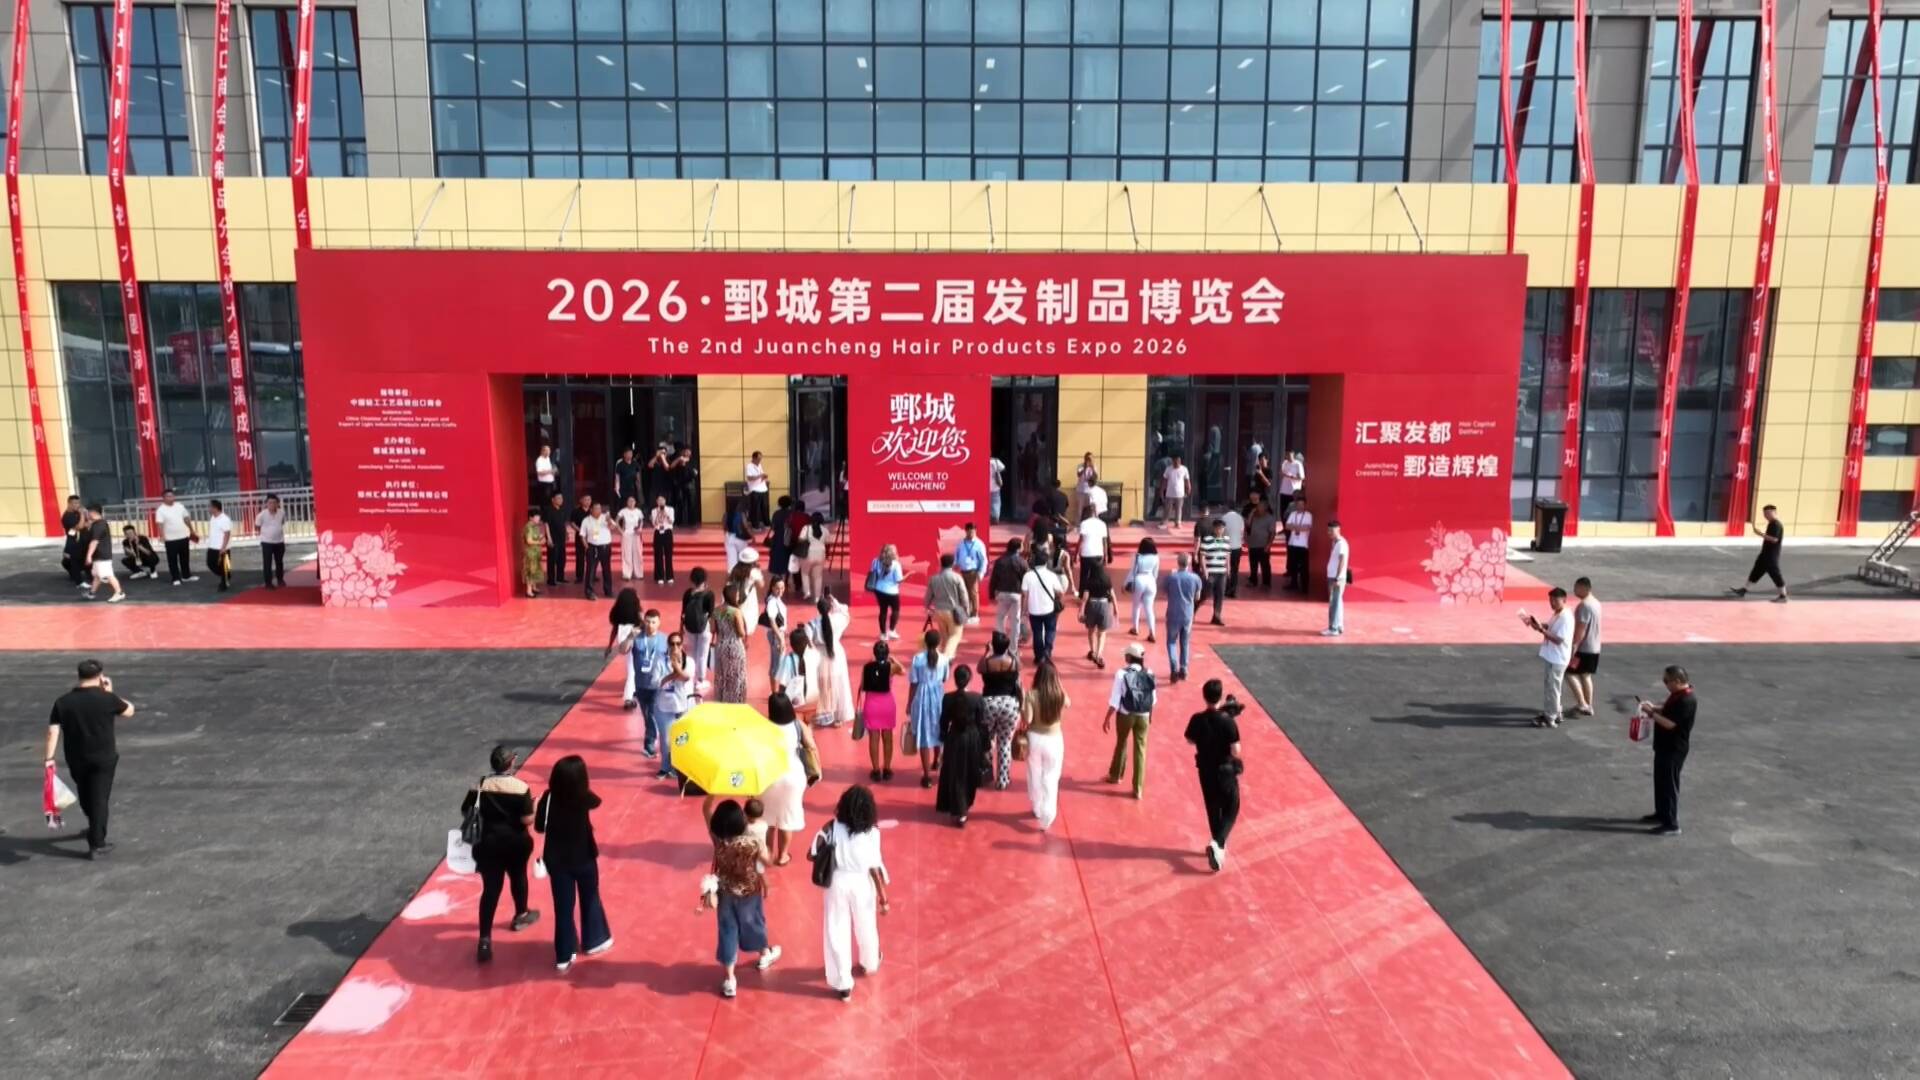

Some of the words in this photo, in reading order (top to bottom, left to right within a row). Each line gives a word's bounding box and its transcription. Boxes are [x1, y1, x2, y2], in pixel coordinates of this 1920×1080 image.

[648, 338, 689, 354] The
[701, 338, 742, 354] 2nd
[754, 338, 882, 358] Juancheng
[892, 338, 942, 354] Hair
[952, 338, 1056, 354] Products
[1068, 338, 1122, 358] Expo
[1132, 338, 1188, 354] 2026
[890, 392, 956, 424] 鄄城
[1356, 420, 1452, 444] 汇聚发都
[872, 426, 970, 466] 欢迎您
[888, 472, 933, 481] WELCOME
[937, 472, 949, 481] TO
[1403, 455, 1499, 478] 鄄造辉煌
[891, 482, 946, 491] JUANCHENG
